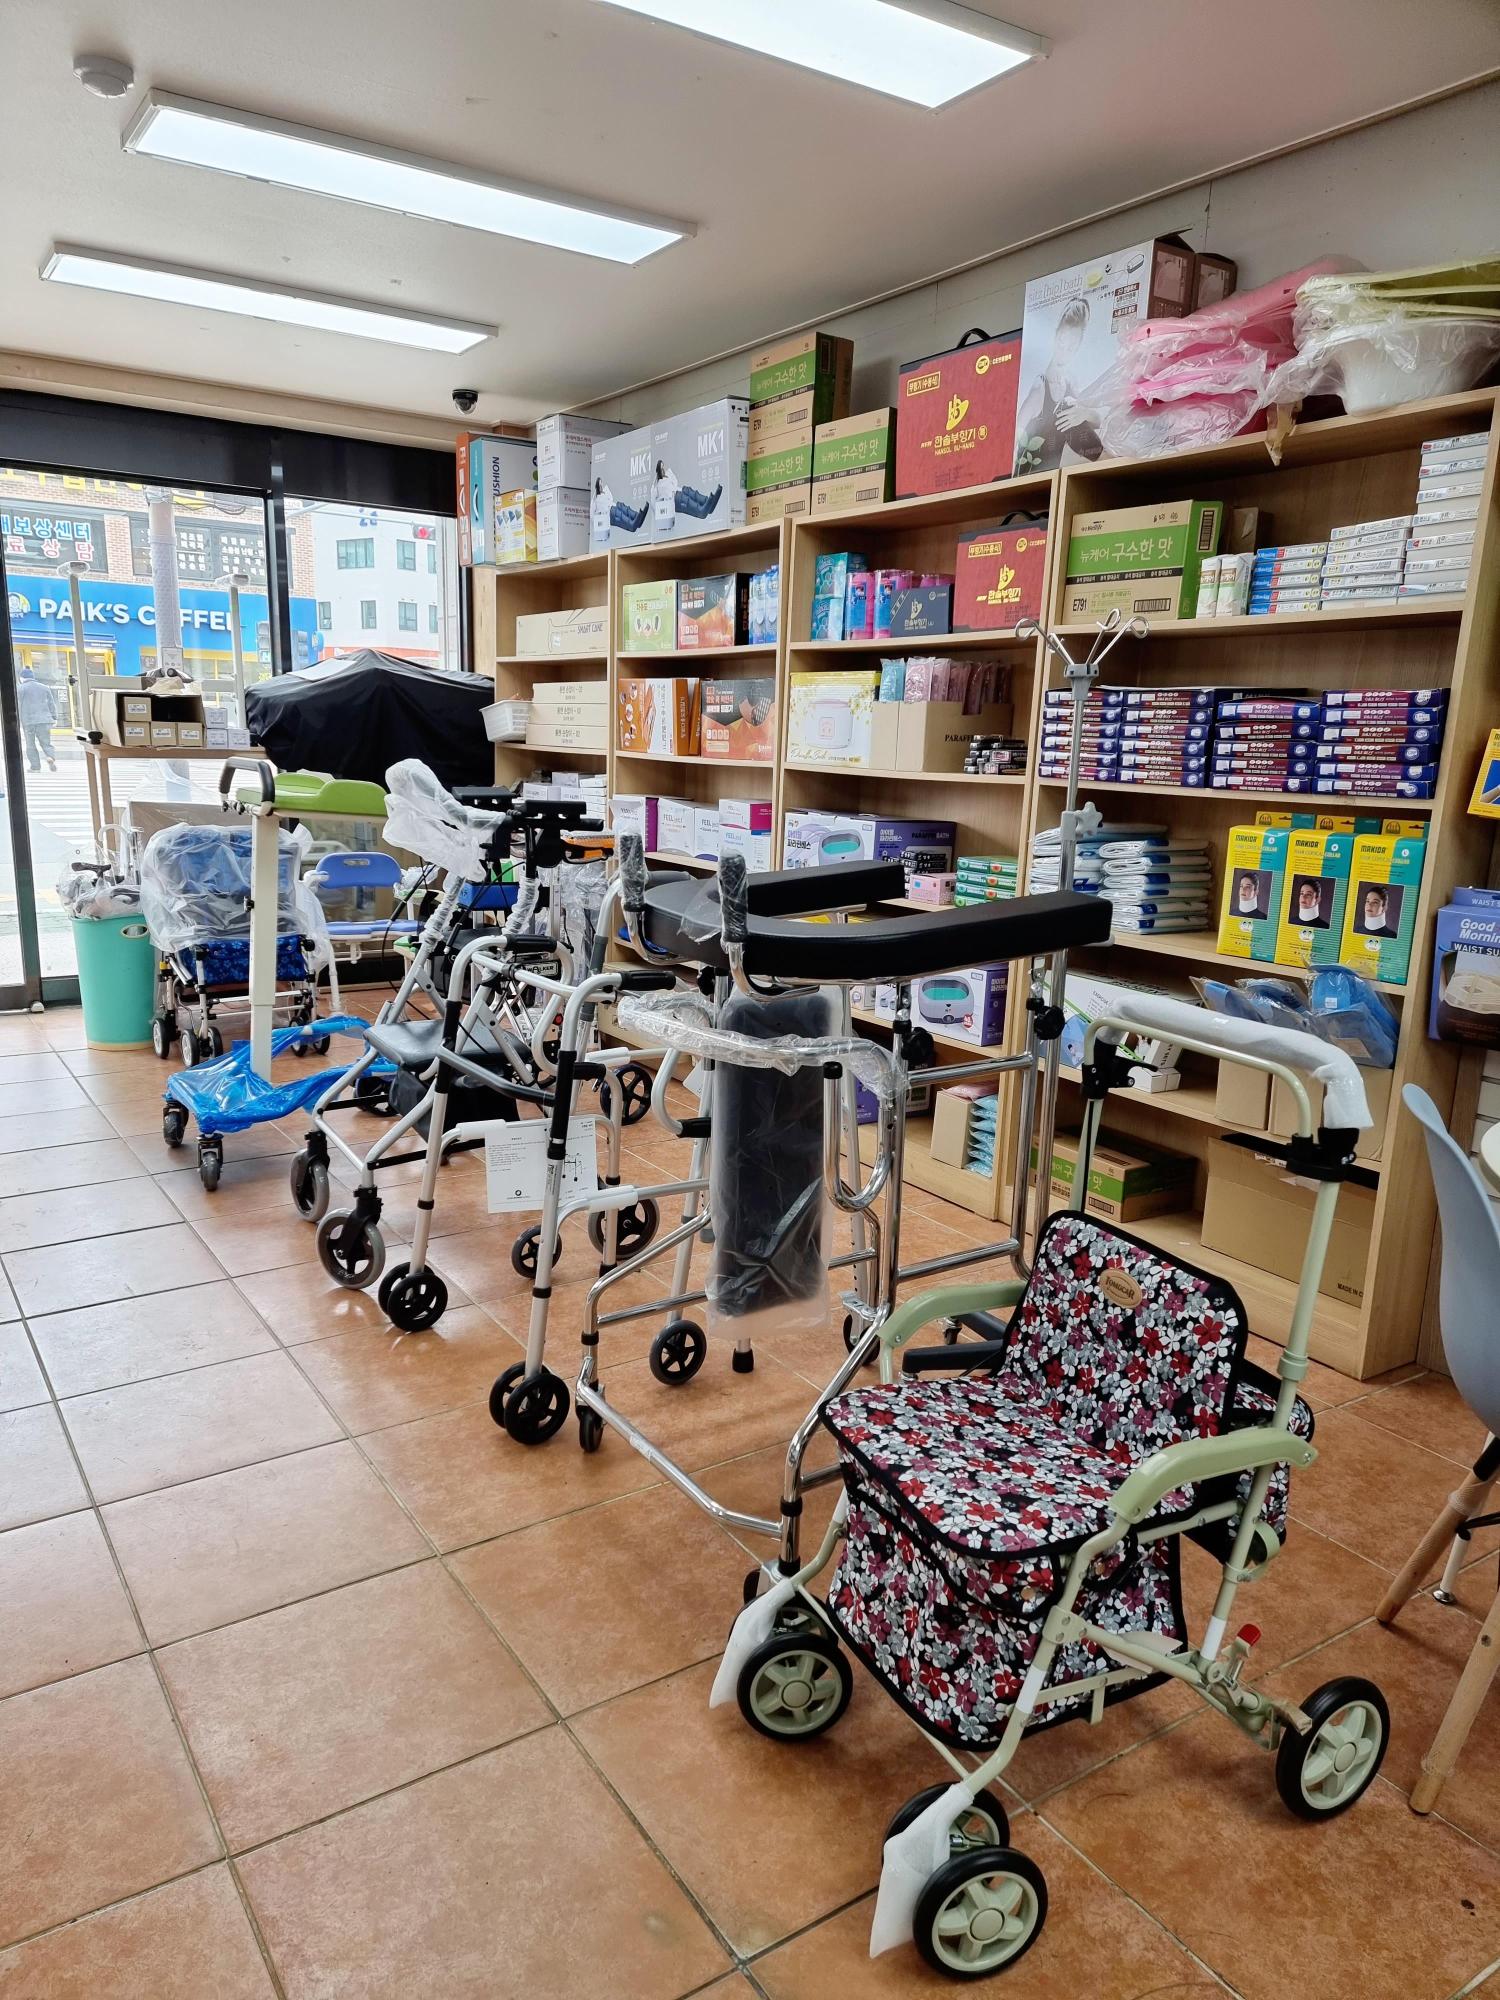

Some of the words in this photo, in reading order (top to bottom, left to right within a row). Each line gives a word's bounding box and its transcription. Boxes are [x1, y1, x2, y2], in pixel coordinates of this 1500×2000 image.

[774, 368, 796, 387] 구수한
[798, 362, 807, 378] 맛
[697, 429, 724, 458] MK1
[841, 444, 867, 462] 구수한
[870, 438, 880, 456] 맛
[934, 445, 952, 456] HANSOL
[630, 452, 652, 477] MK1
[770, 459, 794, 474] 구수한
[796, 456, 804, 471] 맛
[1080, 548, 1110, 564] 뉴케어
[1112, 538, 1154, 562] 구수한
[1158, 536, 1173, 560] 맛
[39, 599, 130, 624] PAIK'S
[1073, 598, 1088, 612] E791
[577, 623, 591, 634] SMART
[1472, 898, 1494, 906] WAIST
[1461, 919, 1496, 931] Good
[1454, 943, 1484, 954] WAIST
[1093, 1176, 1103, 1191] 맛
